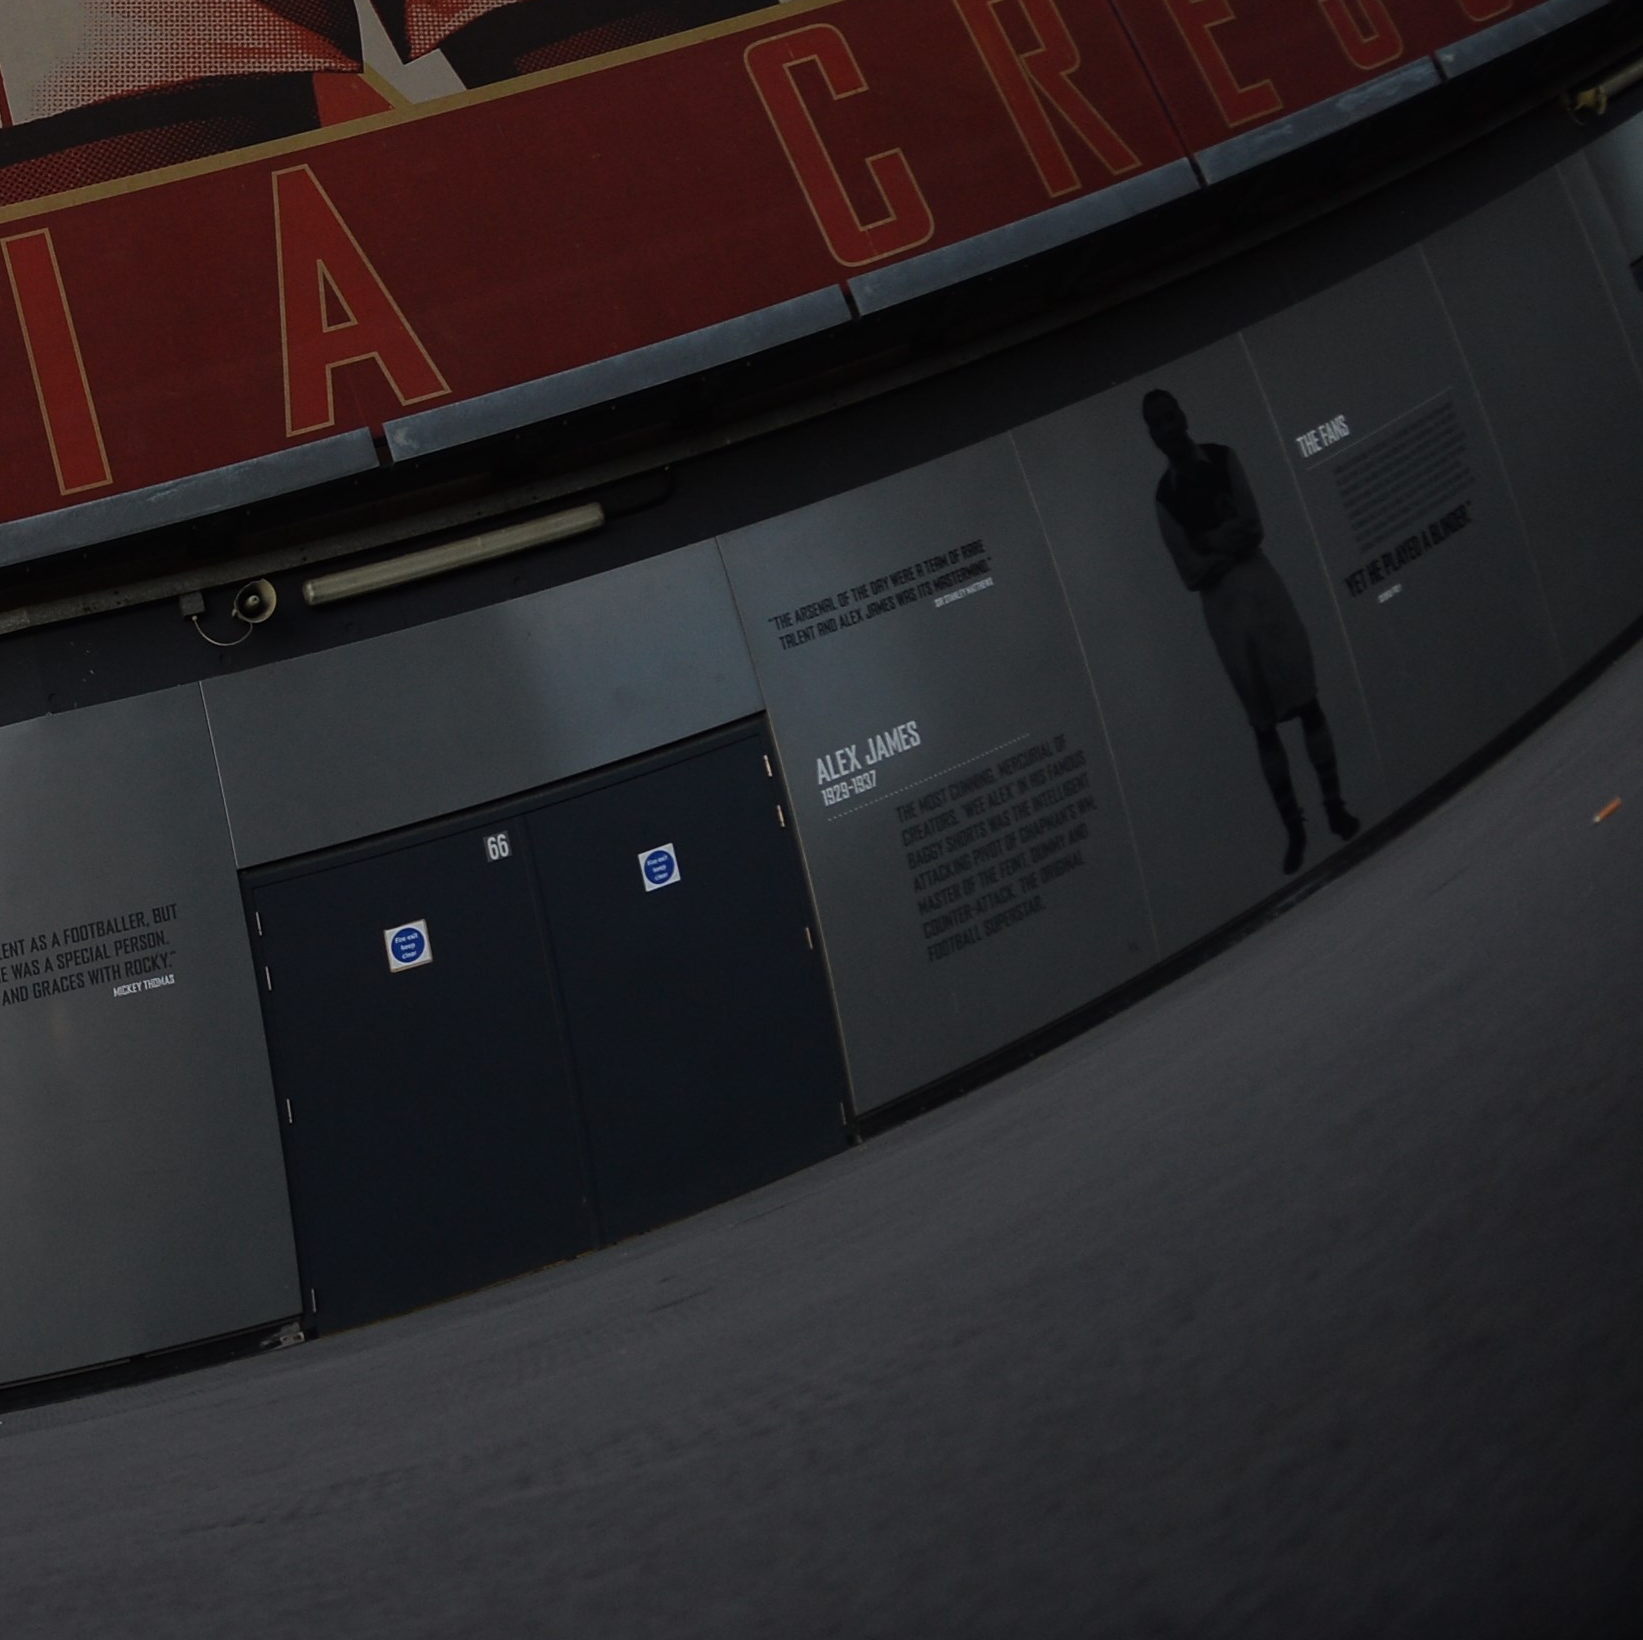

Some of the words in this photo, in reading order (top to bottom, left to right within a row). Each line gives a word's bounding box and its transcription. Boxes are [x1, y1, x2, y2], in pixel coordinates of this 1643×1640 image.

[1296, 430, 1321, 458] THE
[1319, 415, 1351, 446] FANS
[817, 745, 862, 785] ALEX
[865, 720, 921, 765] JAMES
[821, 770, 876, 806] 1929-1937
[487, 834, 509, 860] 66
[30, 935, 48, 953] AS
[51, 932, 62, 948] A
[63, 911, 150, 946] FOOTBALLER,
[152, 903, 177, 923] BUT
[11, 959, 41, 979] WAS
[44, 956, 54, 972] A
[57, 944, 111, 971] SPECIAL
[114, 930, 170, 957] PERSON.
[2, 986, 29, 1007] AND
[34, 975, 85, 1001] GRACES
[88, 966, 122, 987] WITH
